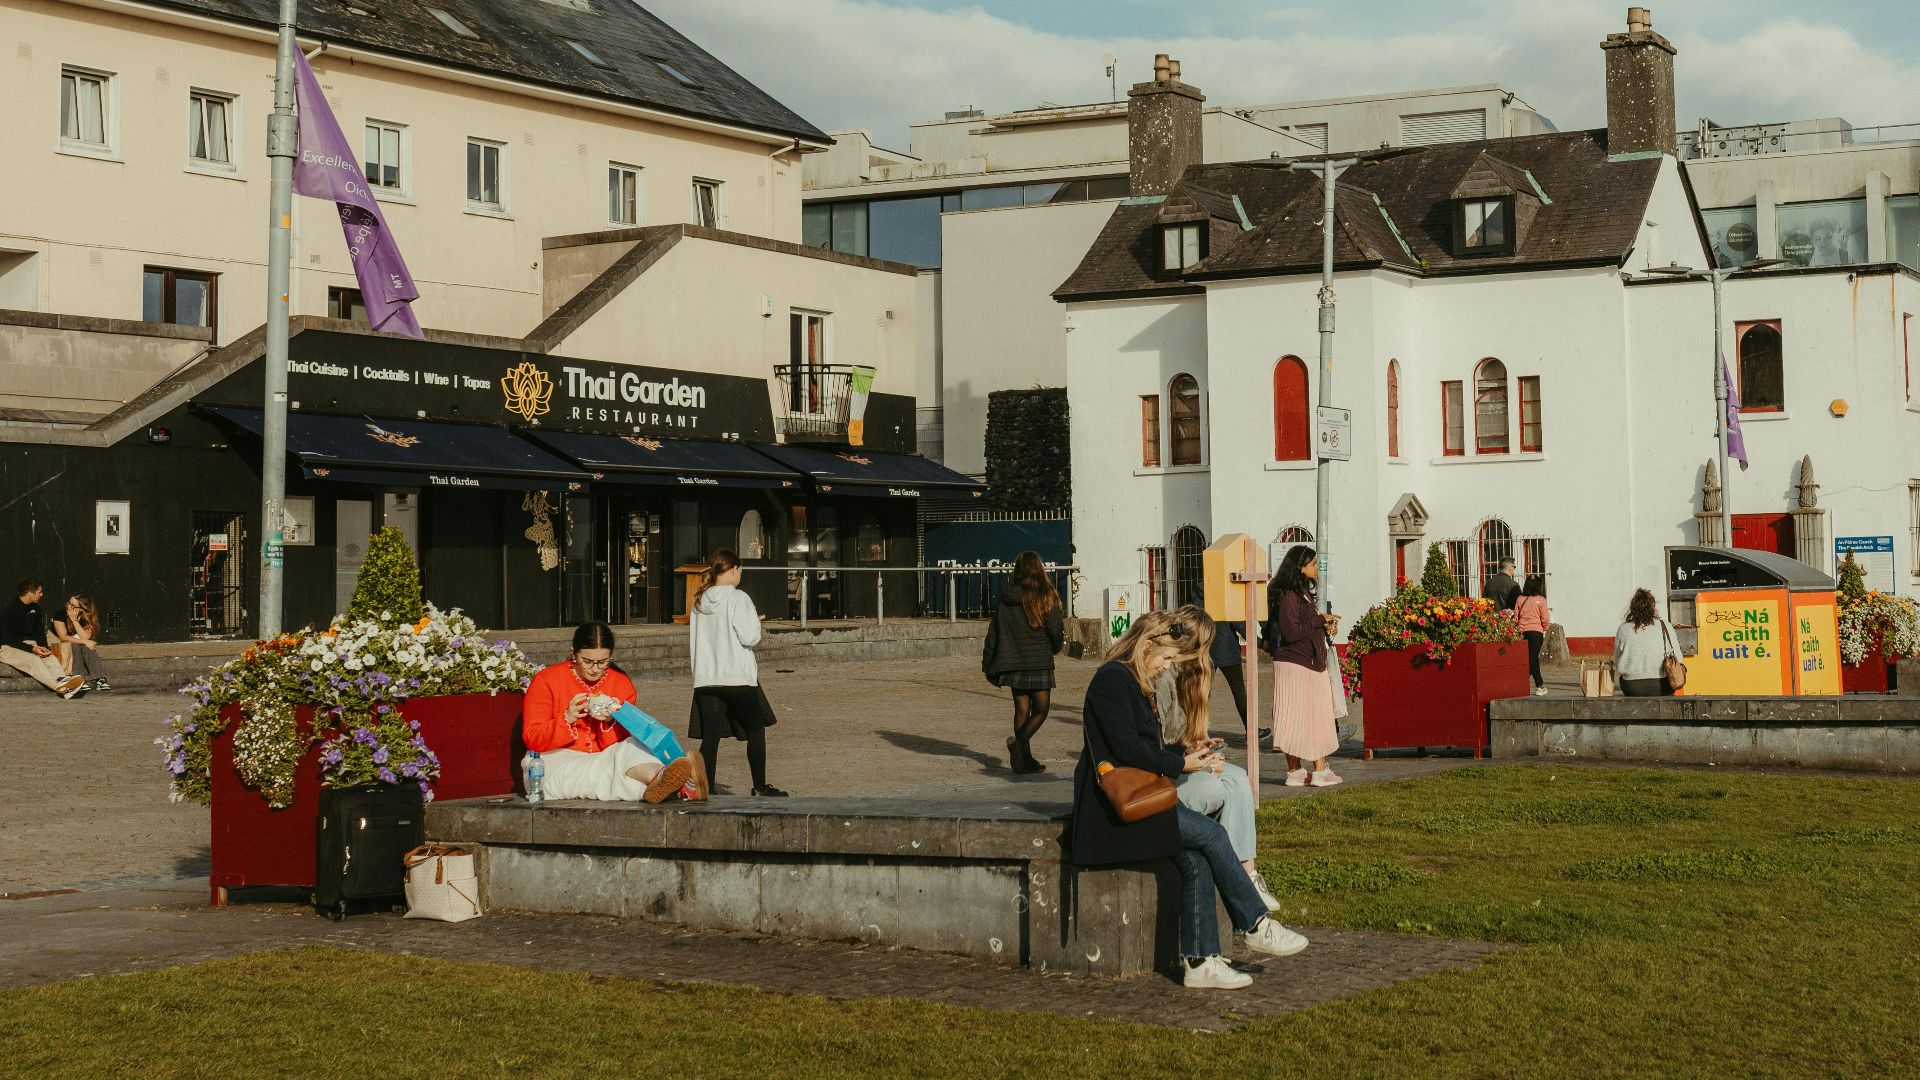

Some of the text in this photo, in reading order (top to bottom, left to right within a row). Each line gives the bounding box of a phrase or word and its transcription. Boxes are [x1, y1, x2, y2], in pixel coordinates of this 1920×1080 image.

[302, 149, 358, 177] Excellen
[287, 360, 491, 390] Thai Cuisine Cocktails Wine Tapas
[563, 366, 706, 409] Thai Garden
[572, 406, 698, 429] RESTAURANT
[430, 475, 480, 486] Thai Garden
[678, 476, 719, 485] Thai Garden
[888, 488, 920, 497] Thai Garden
[938, 558, 981, 574] Thai
[1743, 608, 1769, 624] Ná
[1722, 626, 1770, 642] caith
[1800, 618, 1811, 634] Ná
[1712, 642, 1771, 660] uait é.
[1802, 636, 1820, 653] caith
[1803, 652, 1825, 672] uait é.
